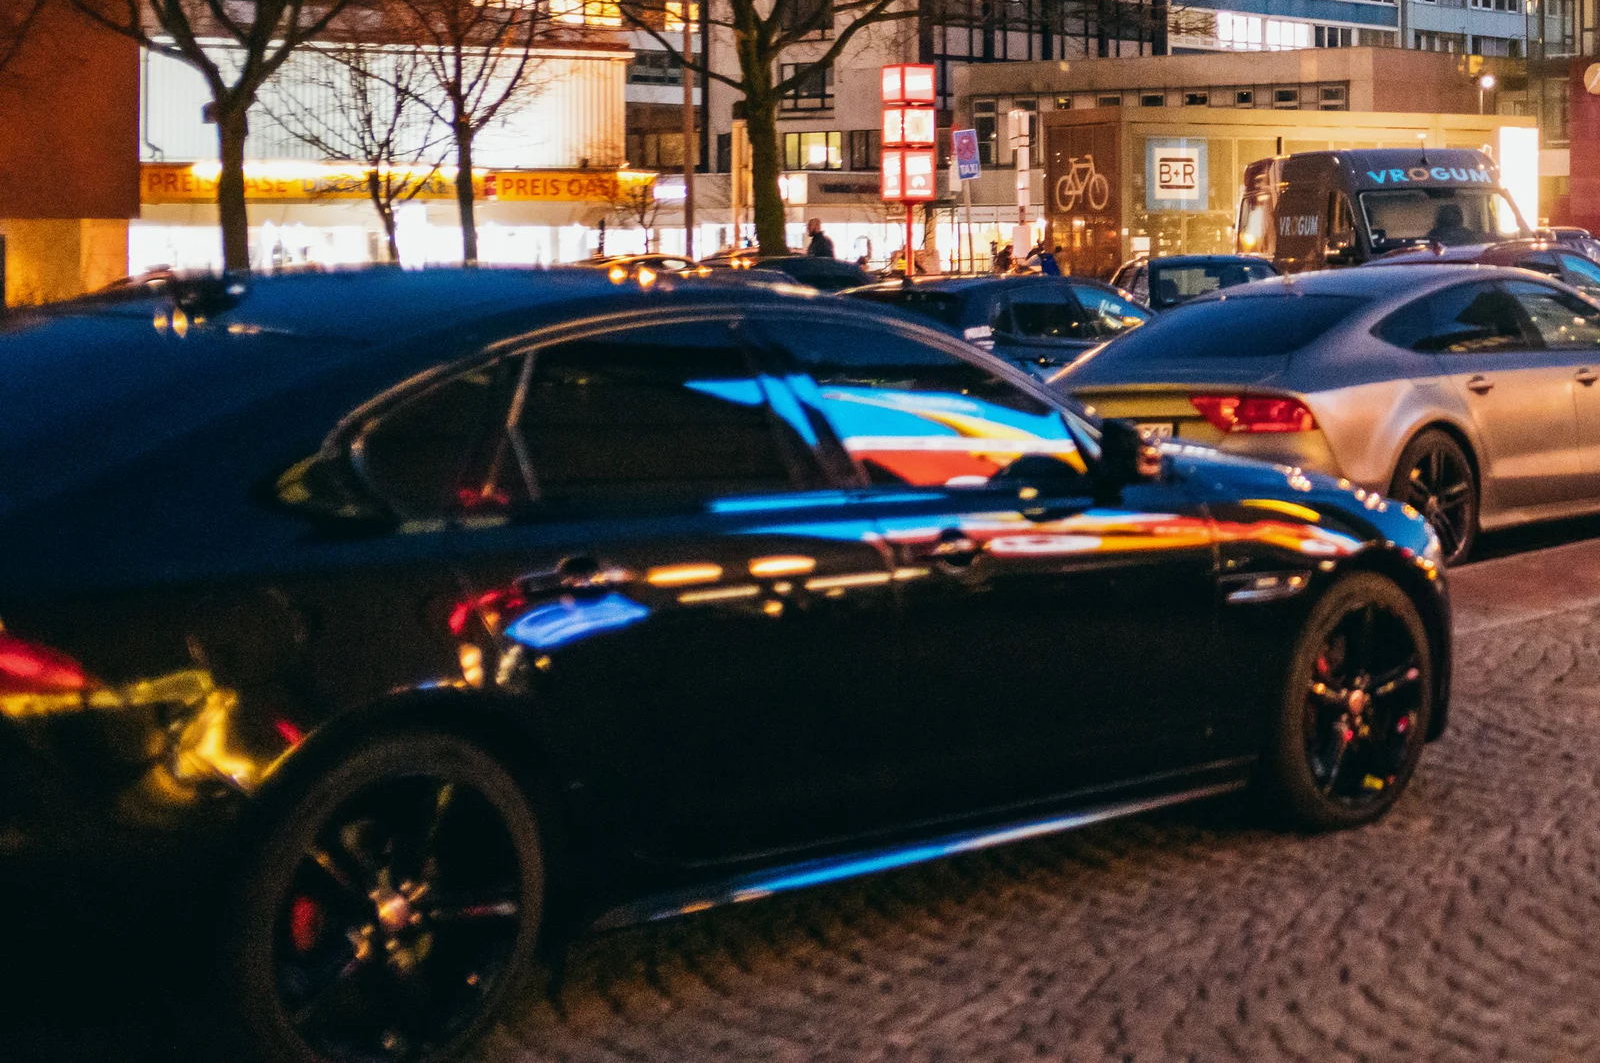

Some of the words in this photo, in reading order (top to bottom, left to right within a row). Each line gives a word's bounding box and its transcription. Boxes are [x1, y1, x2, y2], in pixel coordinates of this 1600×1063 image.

[960, 163, 979, 176] TAXI
[1367, 167, 1492, 185] VROGUM
[502, 178, 560, 196] PREIS
[1279, 215, 1319, 236] VROGUM
